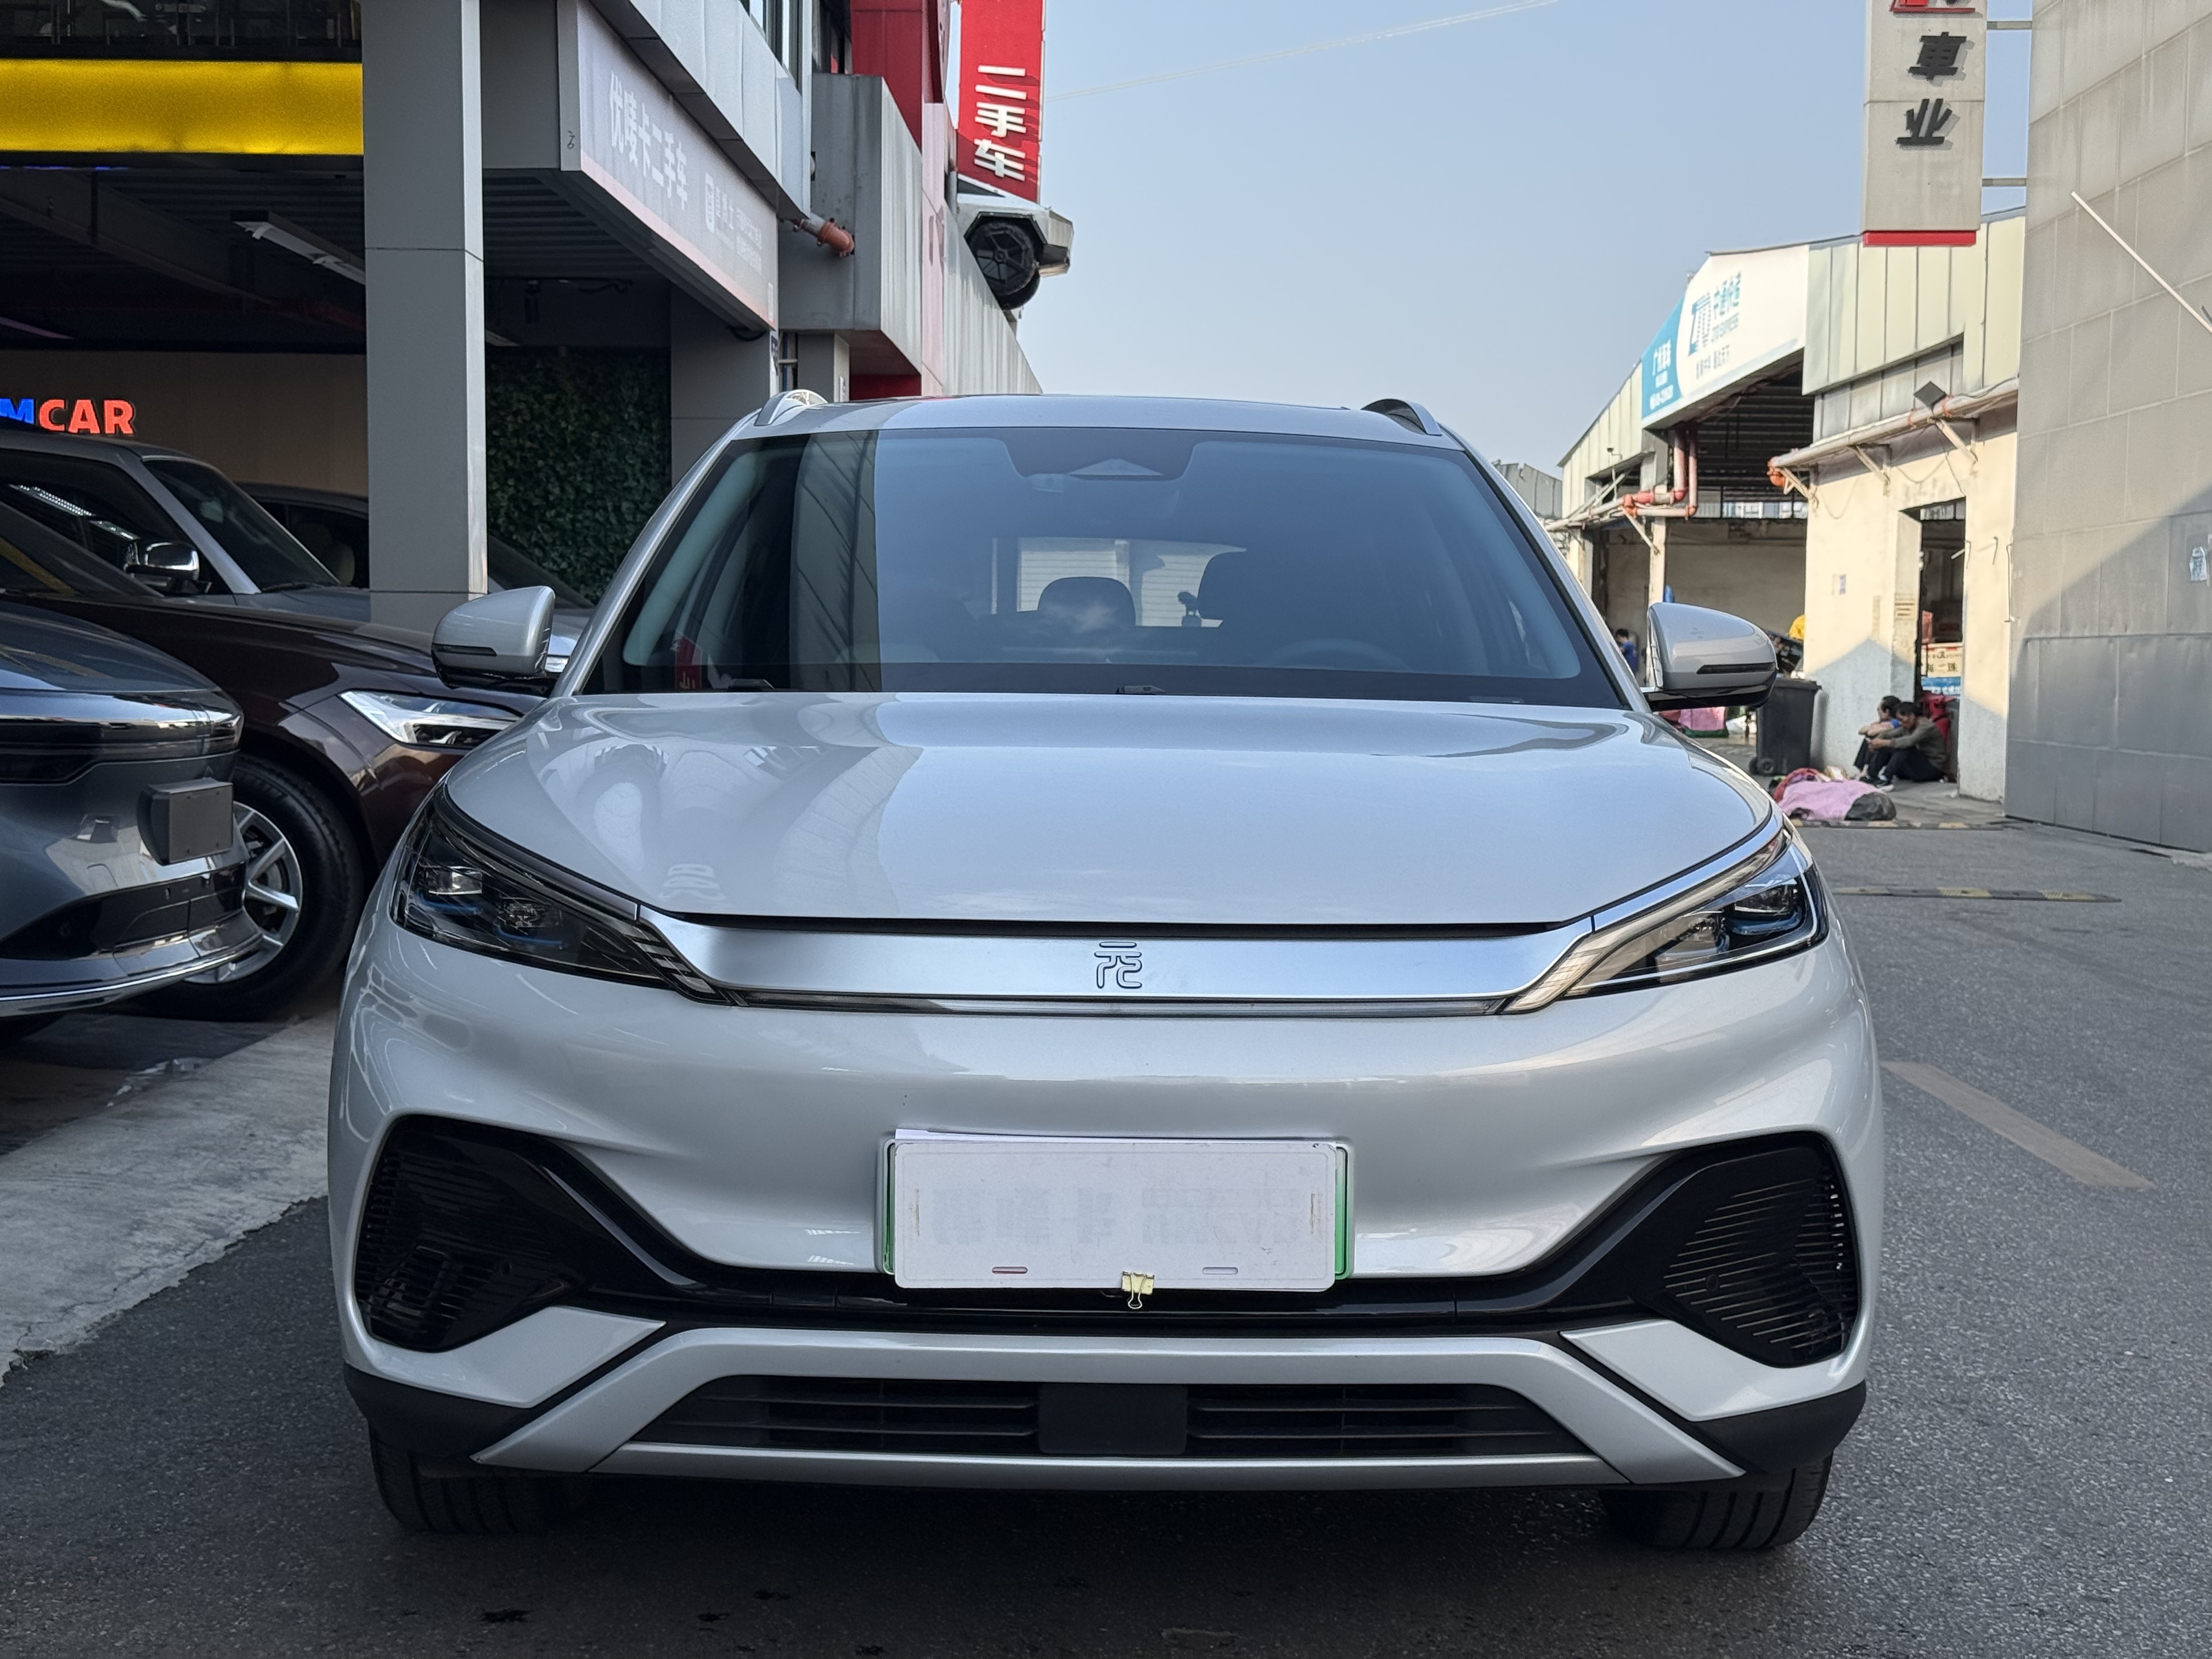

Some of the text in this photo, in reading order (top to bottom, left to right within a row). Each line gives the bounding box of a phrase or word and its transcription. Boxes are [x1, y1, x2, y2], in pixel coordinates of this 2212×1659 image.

[974, 65, 1026, 182] 二手车
[1094, 941, 1142, 989] 元
